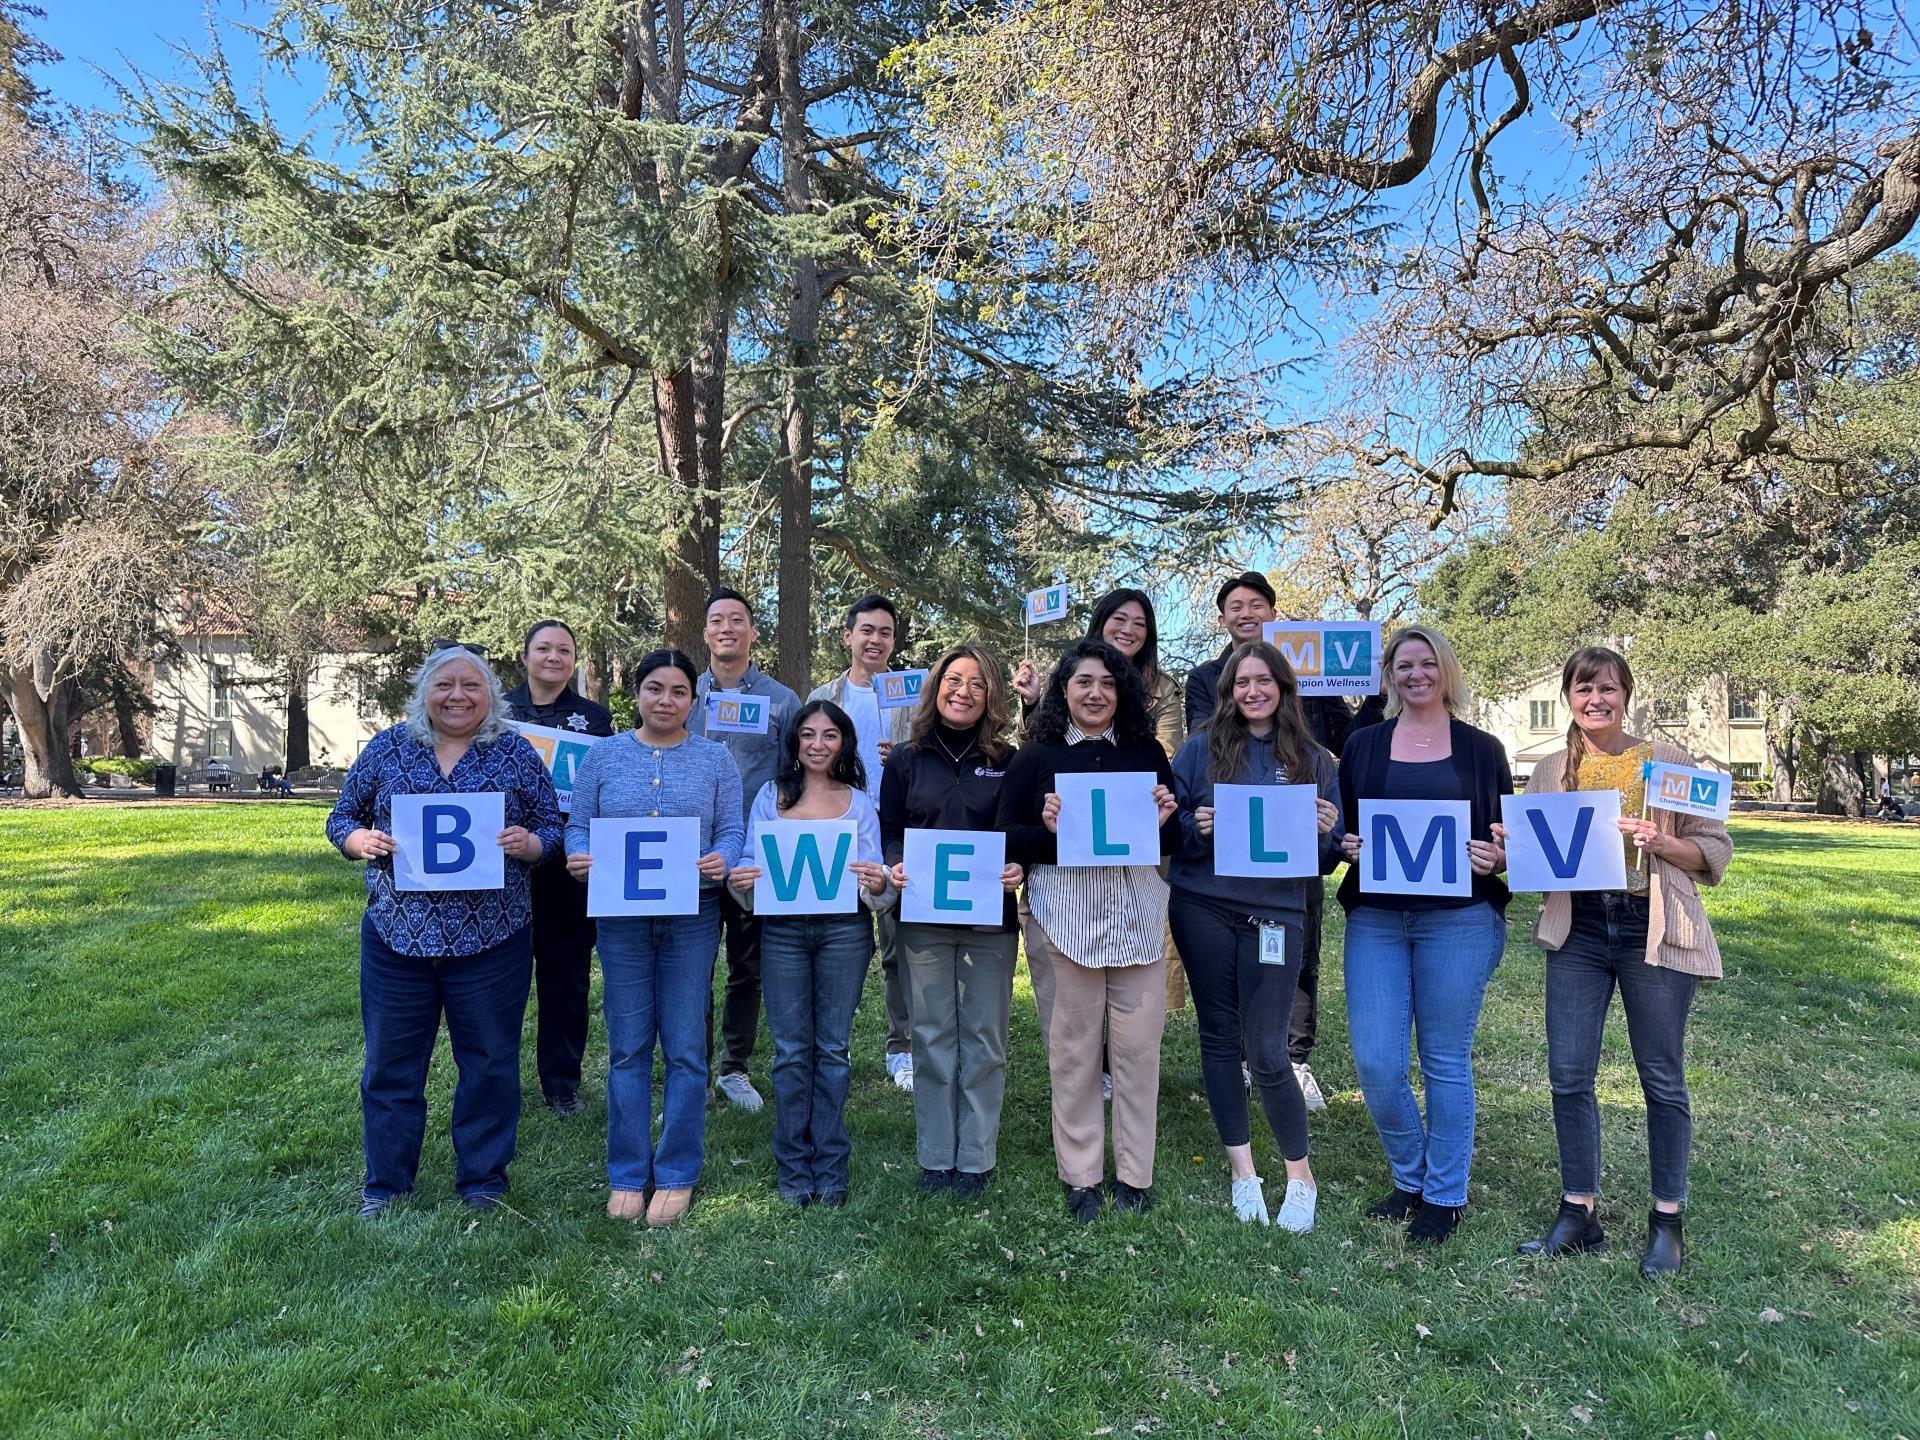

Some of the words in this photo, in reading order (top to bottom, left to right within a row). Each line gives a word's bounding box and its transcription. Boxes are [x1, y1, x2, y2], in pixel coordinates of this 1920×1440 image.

[1326, 678, 1370, 687] Wellness
[1090, 788, 1131, 856] L
[1248, 796, 1289, 863] L
[1660, 797, 1688, 808] Champion
[422, 804, 476, 875] B
[623, 830, 668, 901] E
[760, 832, 853, 902] W
[1371, 813, 1457, 884] M
[1525, 806, 1595, 879] V
[933, 843, 975, 912] E
